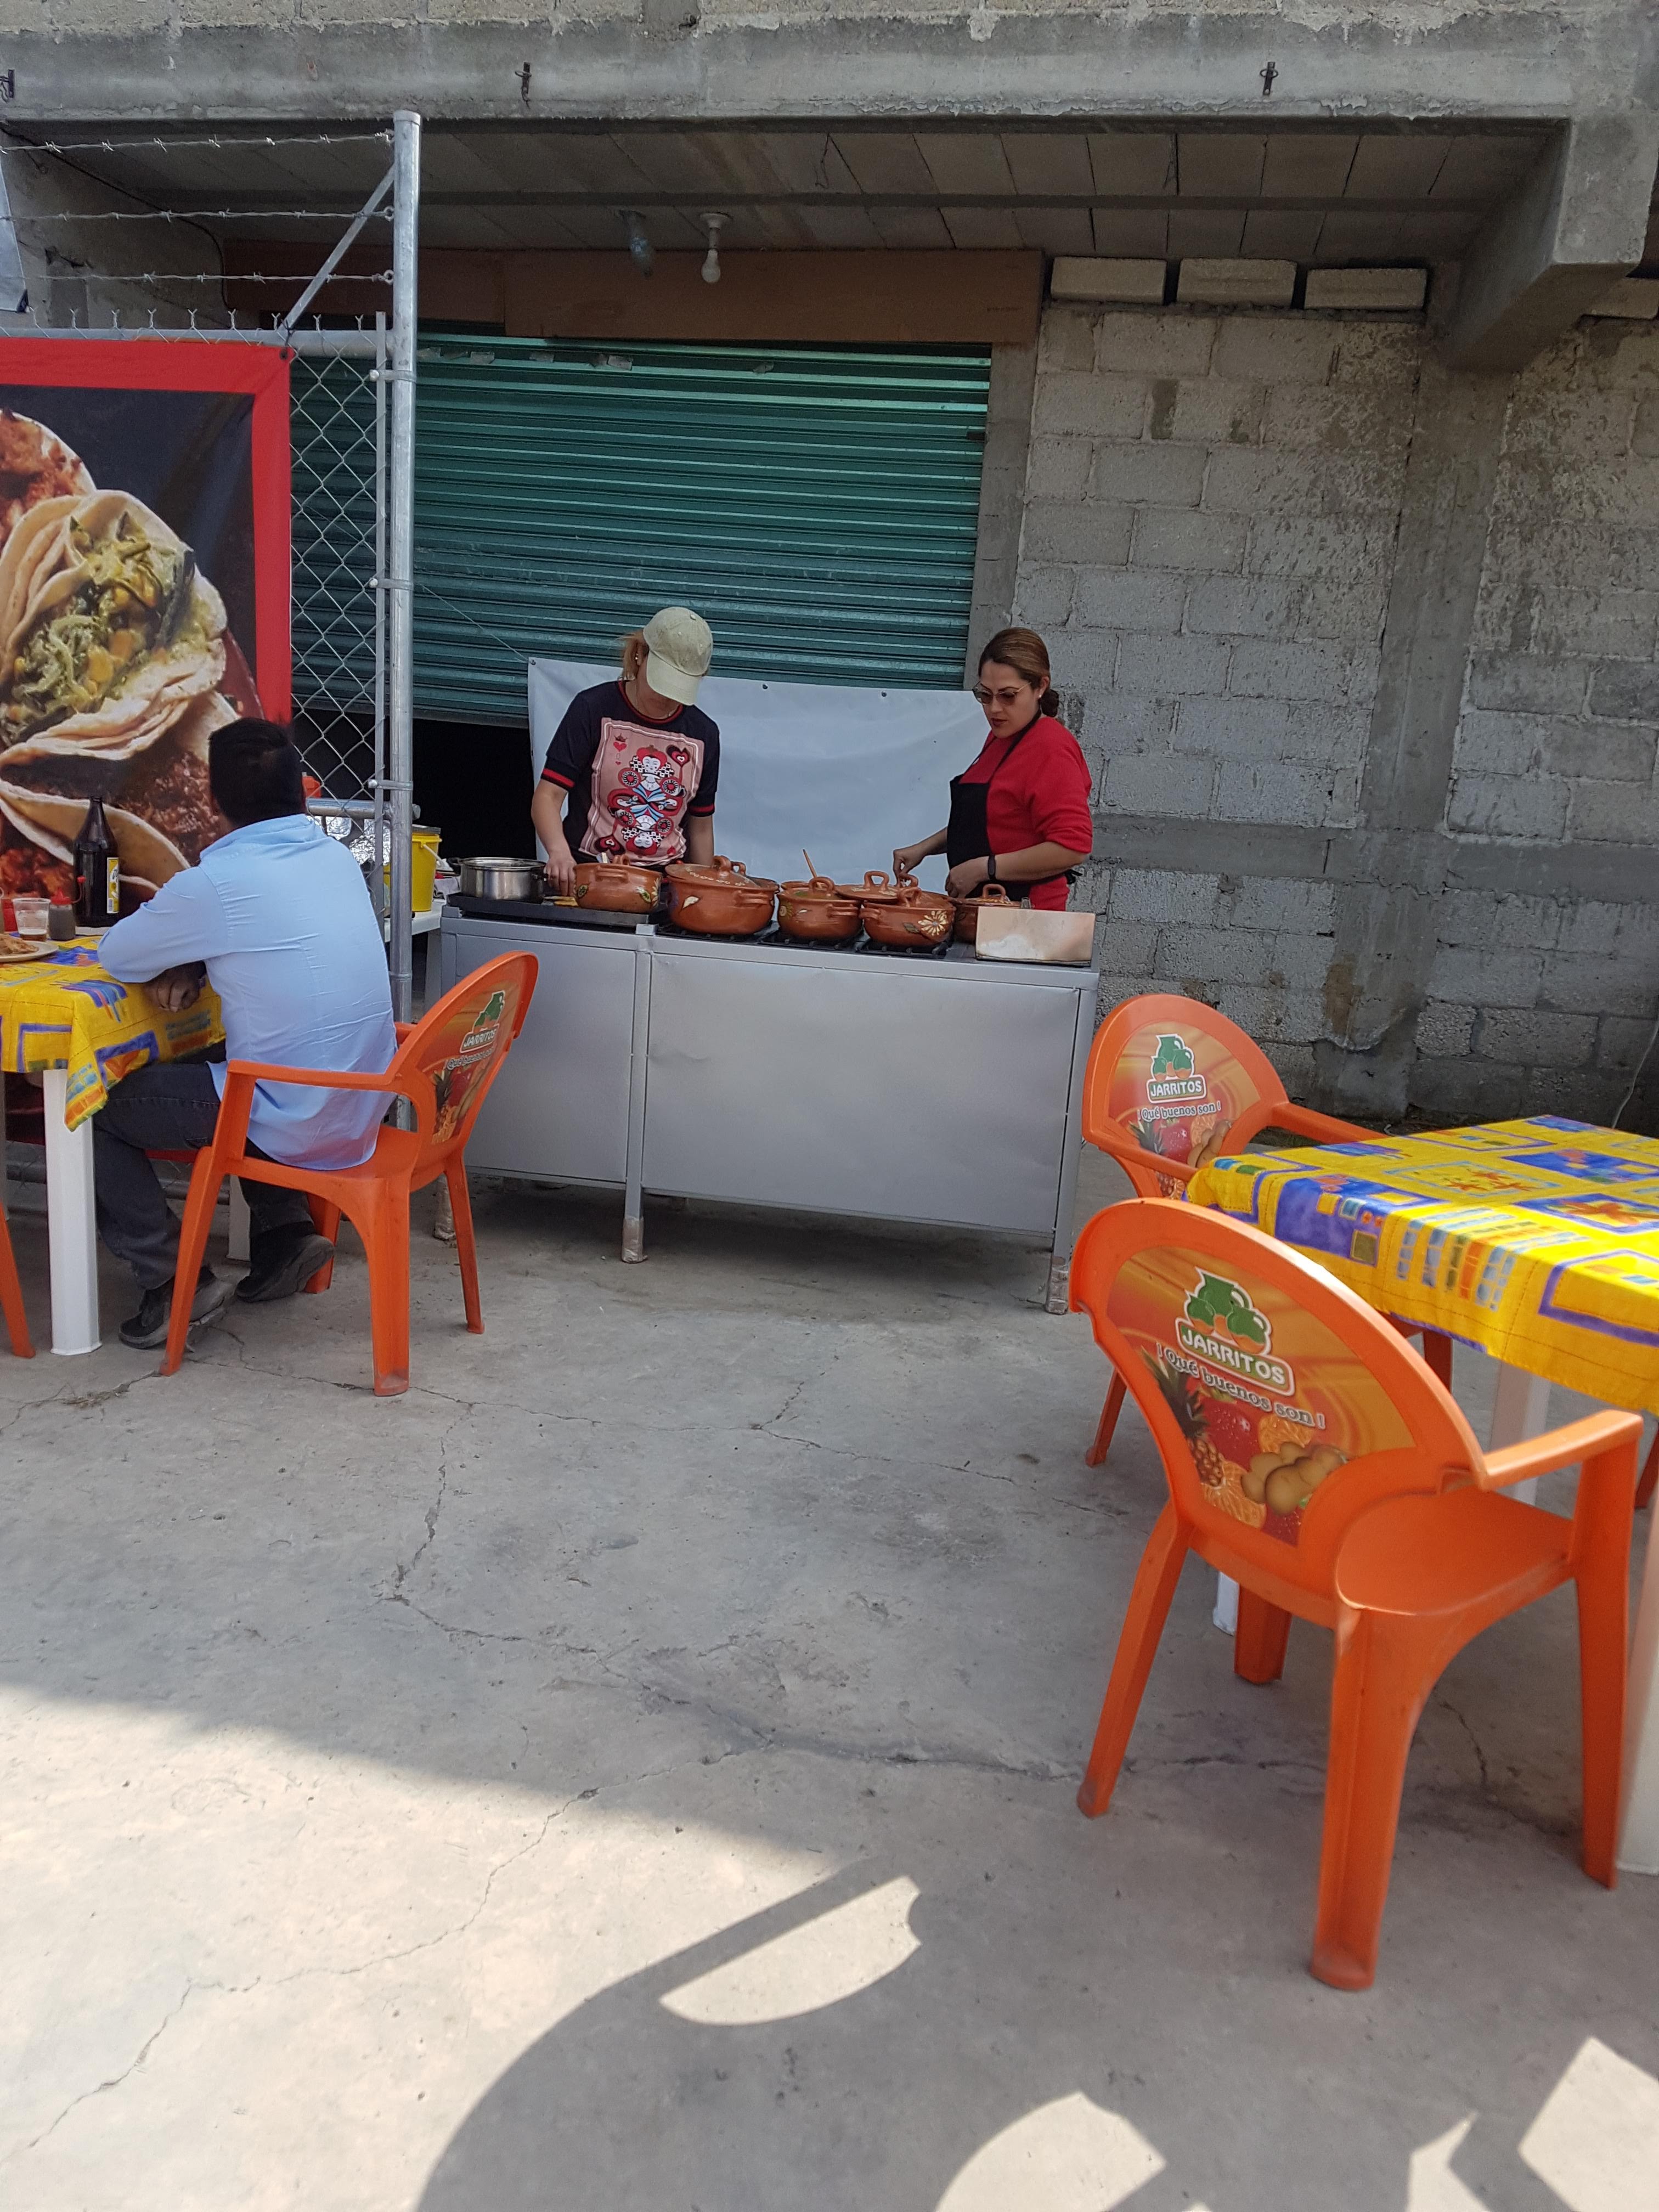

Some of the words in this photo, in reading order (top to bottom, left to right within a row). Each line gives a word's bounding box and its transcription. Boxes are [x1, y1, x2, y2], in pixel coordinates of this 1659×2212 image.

[1150, 1080, 1202, 1097] JARRITOS
[1160, 1105, 1195, 1119] buenos
[1183, 1329, 1285, 1385] JARRITOS
[1200, 1365, 1272, 1412] buenos
